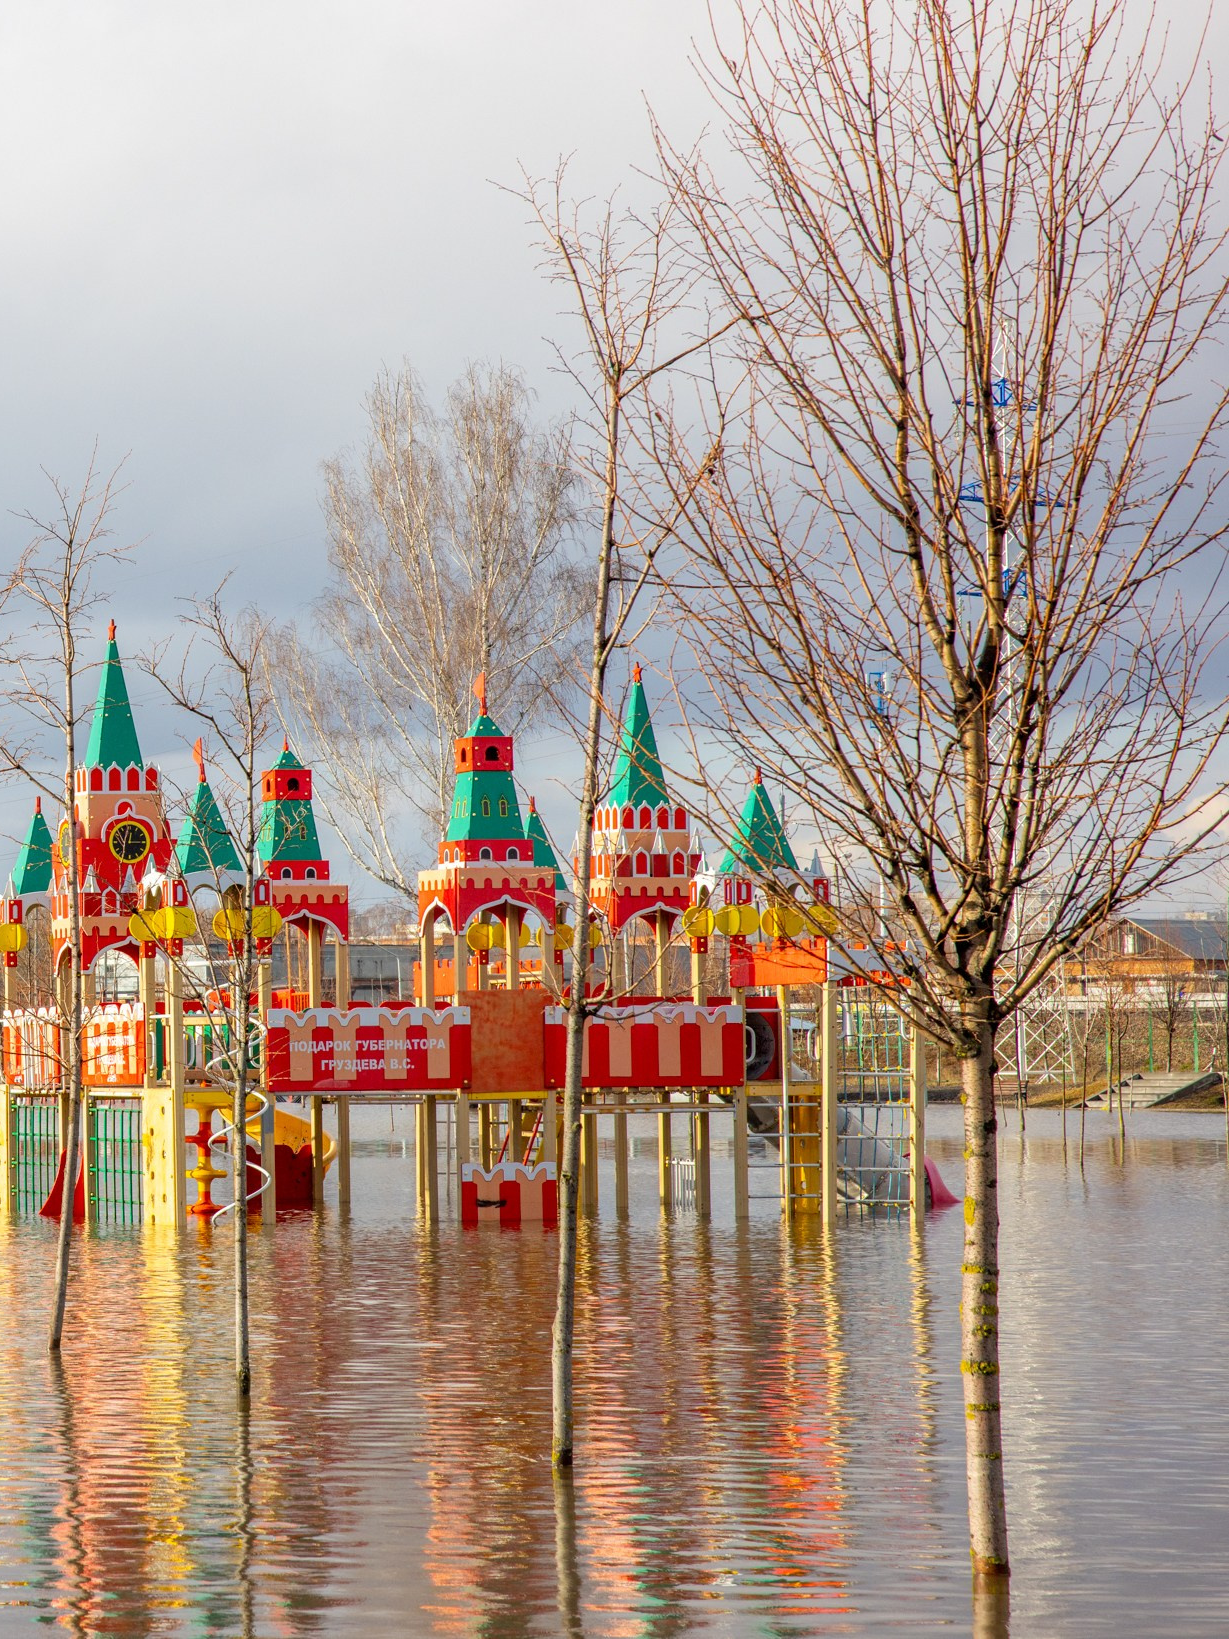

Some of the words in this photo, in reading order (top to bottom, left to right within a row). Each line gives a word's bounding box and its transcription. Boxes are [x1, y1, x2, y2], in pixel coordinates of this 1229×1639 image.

[289, 1040, 351, 1053] ПОДАРОК
[355, 1038, 446, 1051] ГУБЕРНАТОРА
[321, 1058, 386, 1071] ГРУЗДЕВА
[390, 1058, 415, 1069] В.С.
